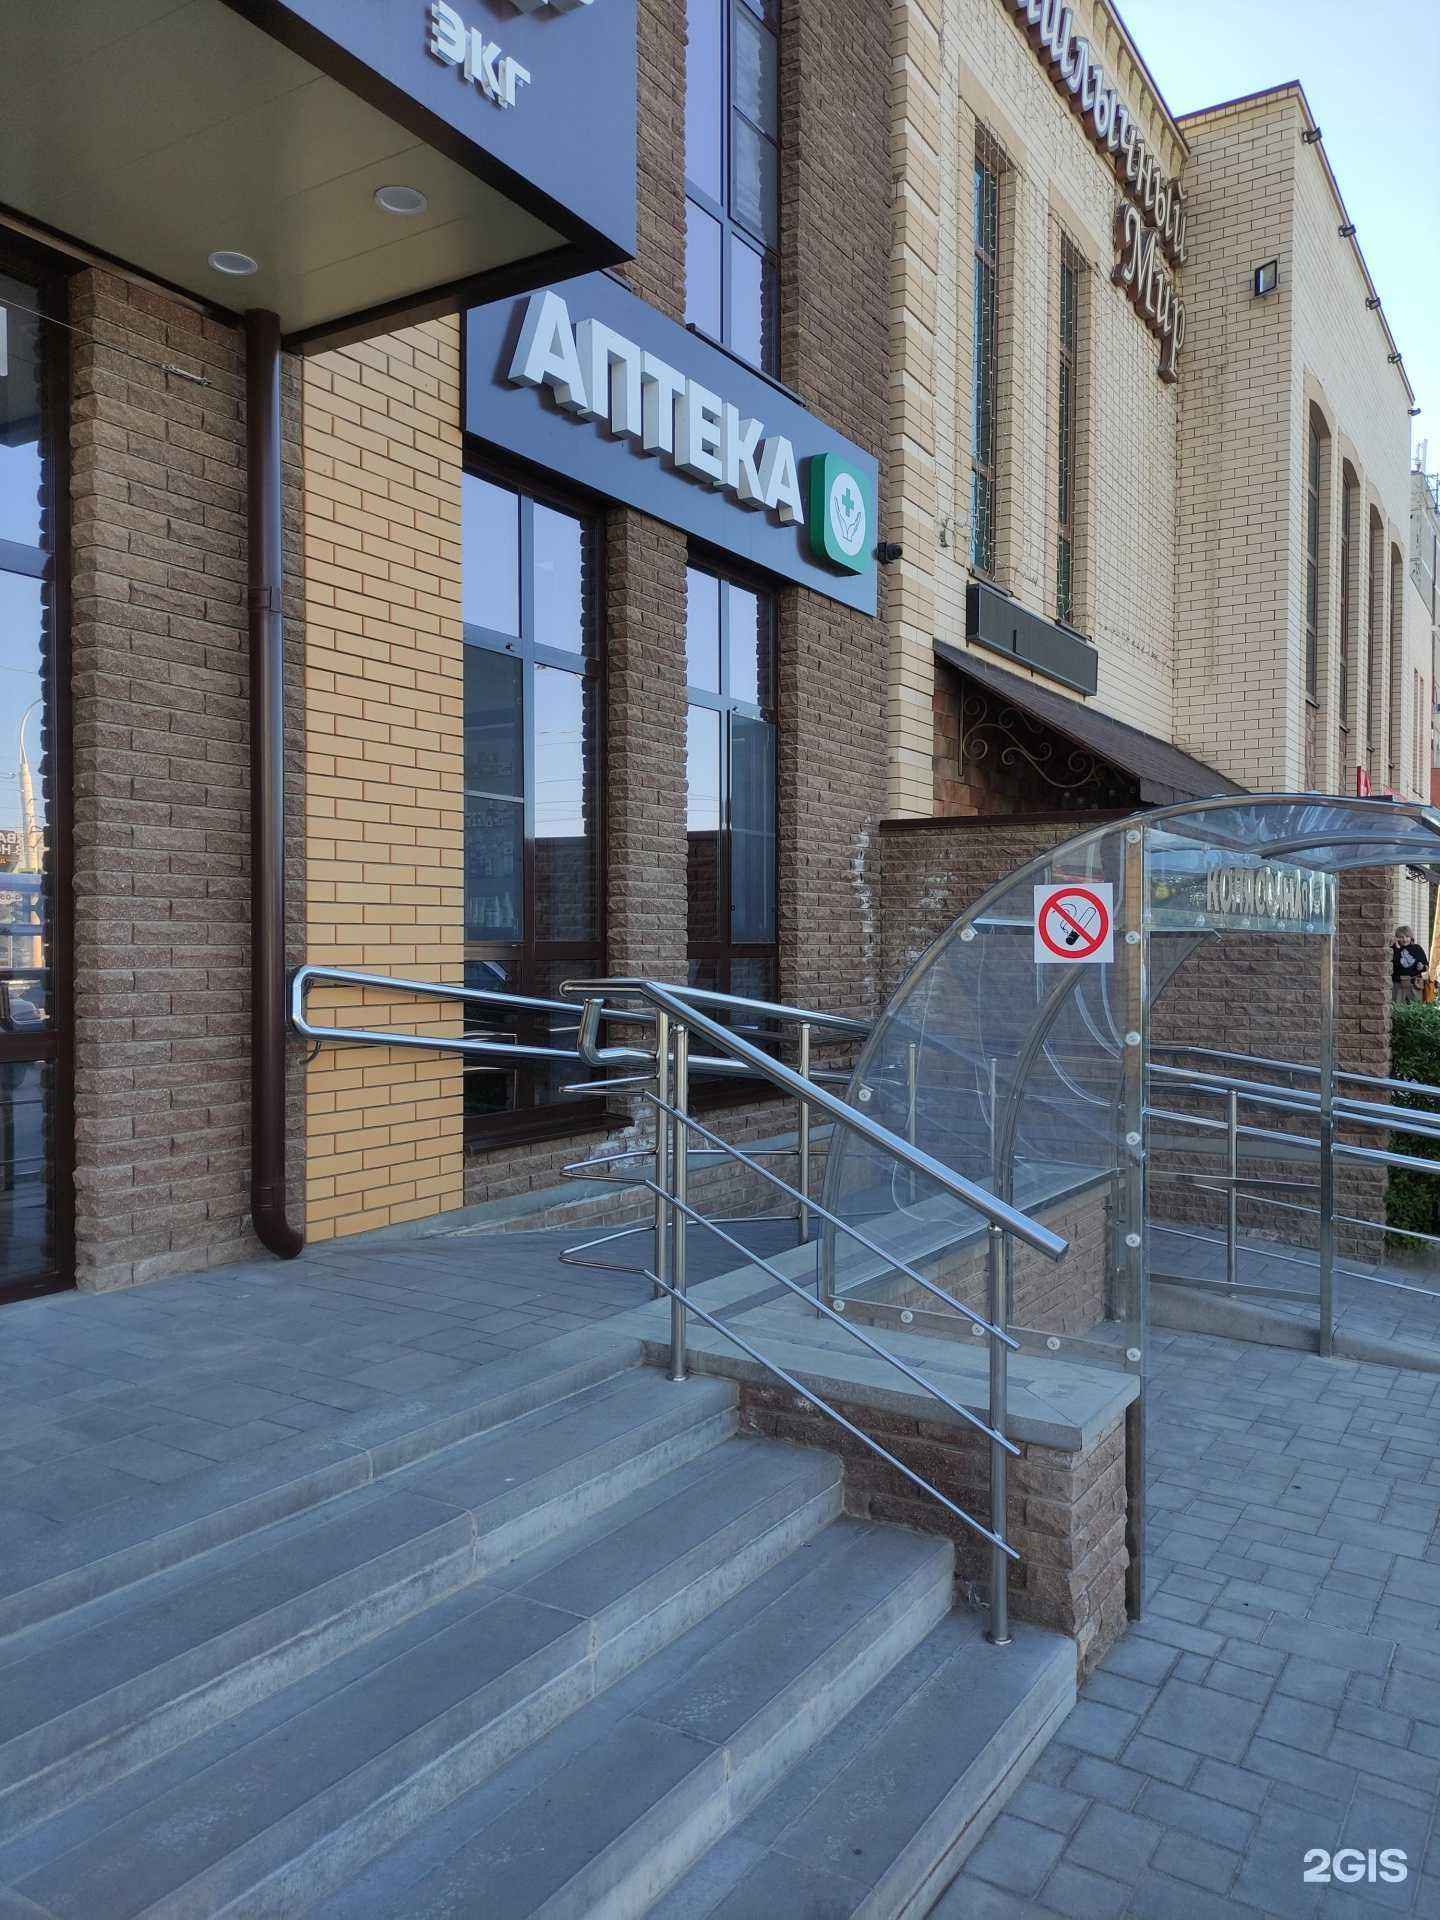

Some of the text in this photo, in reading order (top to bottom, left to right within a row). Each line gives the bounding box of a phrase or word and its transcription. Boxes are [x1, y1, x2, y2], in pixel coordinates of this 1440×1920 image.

[430, 0, 531, 109] ЭКГ
[1015, 0, 1188, 266] шлычный
[1114, 204, 1187, 382] Мир
[507, 289, 806, 527] АПТЕКА
